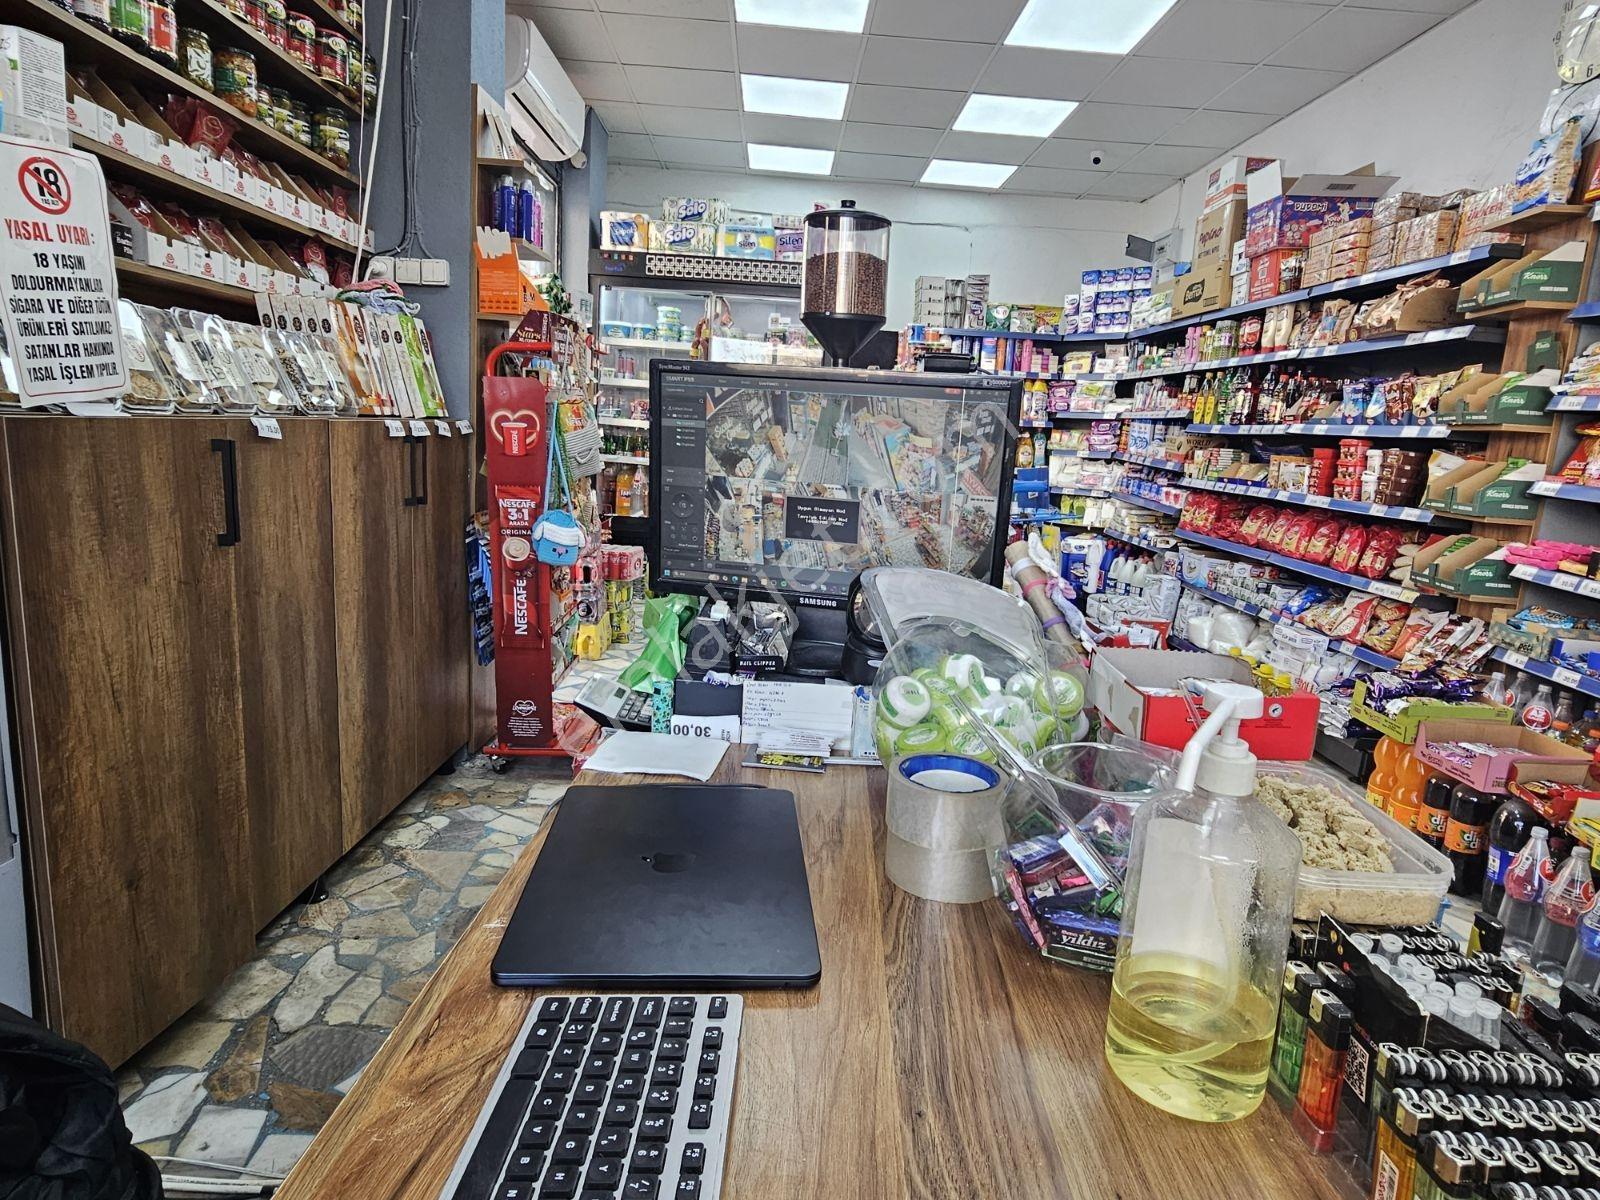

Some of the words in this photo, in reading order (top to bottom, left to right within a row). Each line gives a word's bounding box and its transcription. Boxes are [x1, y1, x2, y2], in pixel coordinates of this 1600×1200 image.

[1586, 64, 1594, 78] 6
[678, 202, 707, 217] Solo
[4, 218, 54, 242] YASAL
[665, 227, 695, 243] Solo
[33, 252, 49, 268] 18
[52, 253, 86, 275] YAŞINI
[11, 274, 104, 293] DOLDURMAYANLARA
[9, 294, 46, 314] SİGARA
[47, 298, 66, 314] VE
[68, 295, 94, 314] DİĞER
[16, 318, 69, 337] ÜRÜNLERİ
[24, 343, 82, 360] SATANLAR
[82, 341, 115, 358] HAKKINDA
[27, 366, 57, 384] YASAL
[59, 362, 95, 385] İŞLEM
[799, 597, 837, 608] SAMSUNG
[673, 723, 712, 737] 30,00
[1061, 935, 1107, 949] yıldız
